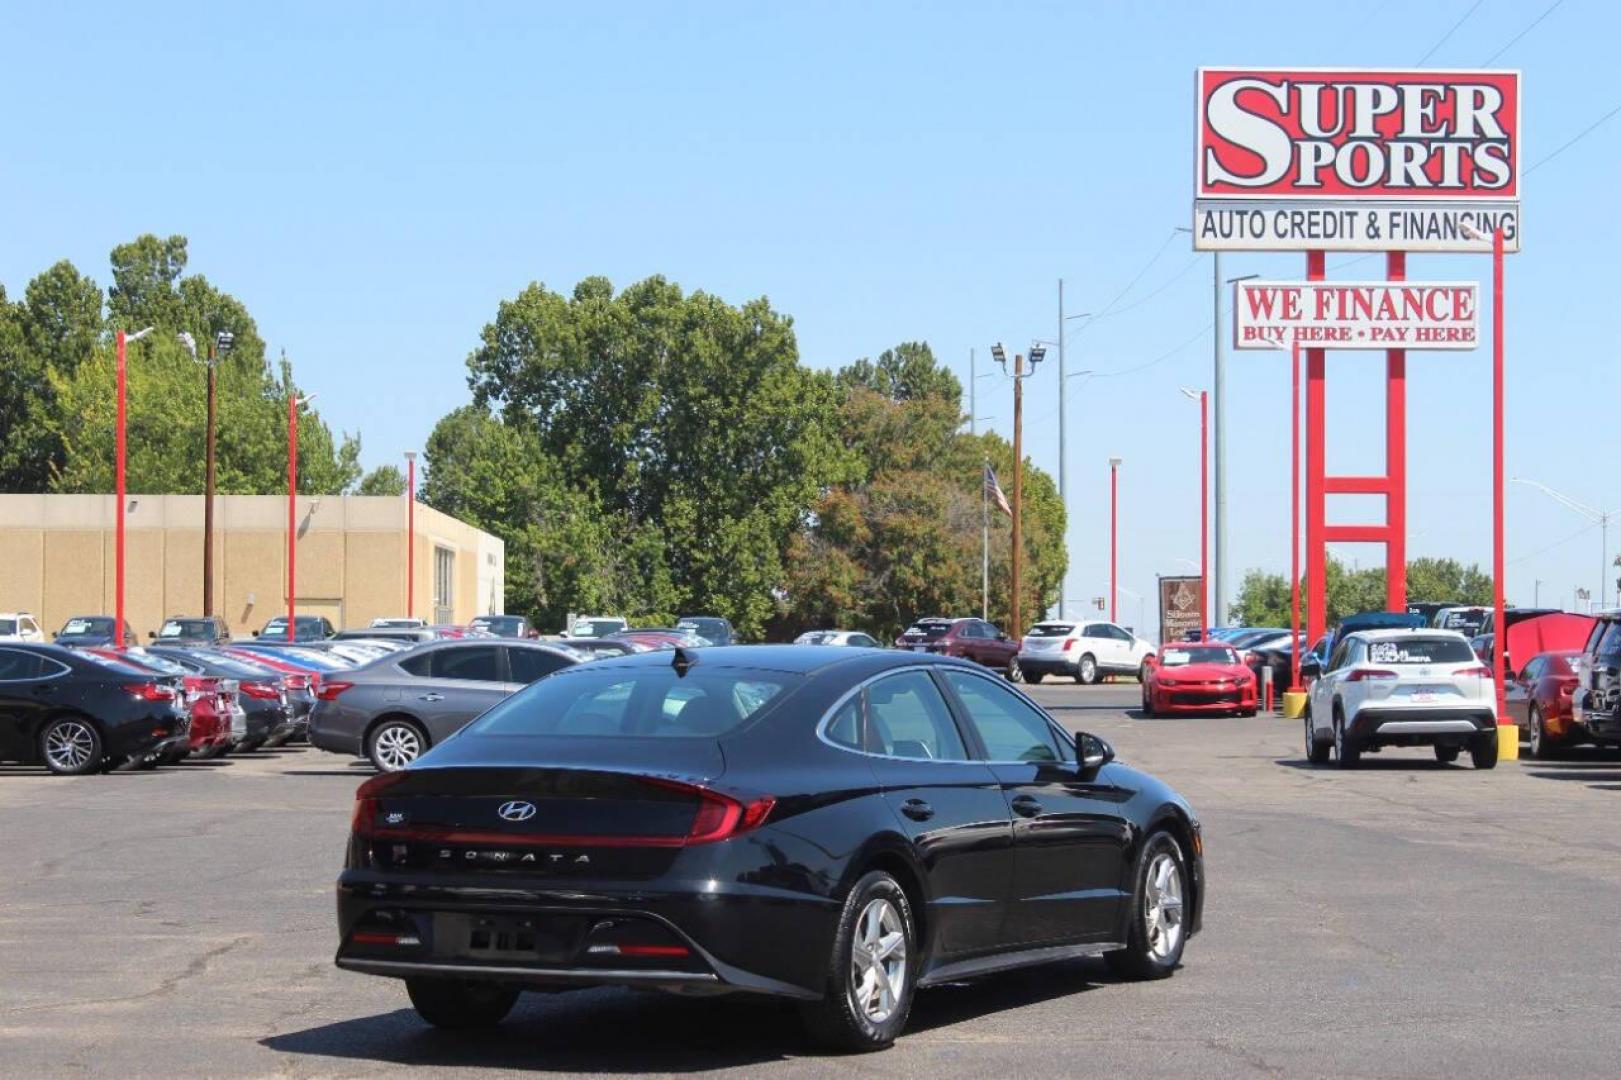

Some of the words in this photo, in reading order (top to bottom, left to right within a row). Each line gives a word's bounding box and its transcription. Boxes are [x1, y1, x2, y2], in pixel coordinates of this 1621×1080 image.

[1206, 78, 1508, 187] SUPER
[1201, 210, 1266, 239] AUTO
[1273, 210, 1358, 239] CREDIT
[1365, 212, 1380, 239] &
[1388, 211, 1516, 241] FINANCING
[1244, 287, 1302, 320] WE
[1313, 287, 1474, 321] FINANCE
[1243, 326, 1287, 341] BUY
[1293, 326, 1351, 341] HERE
[1370, 327, 1409, 342] PAY
[1414, 327, 1475, 342] HERE
[439, 849, 590, 863] SONATA
